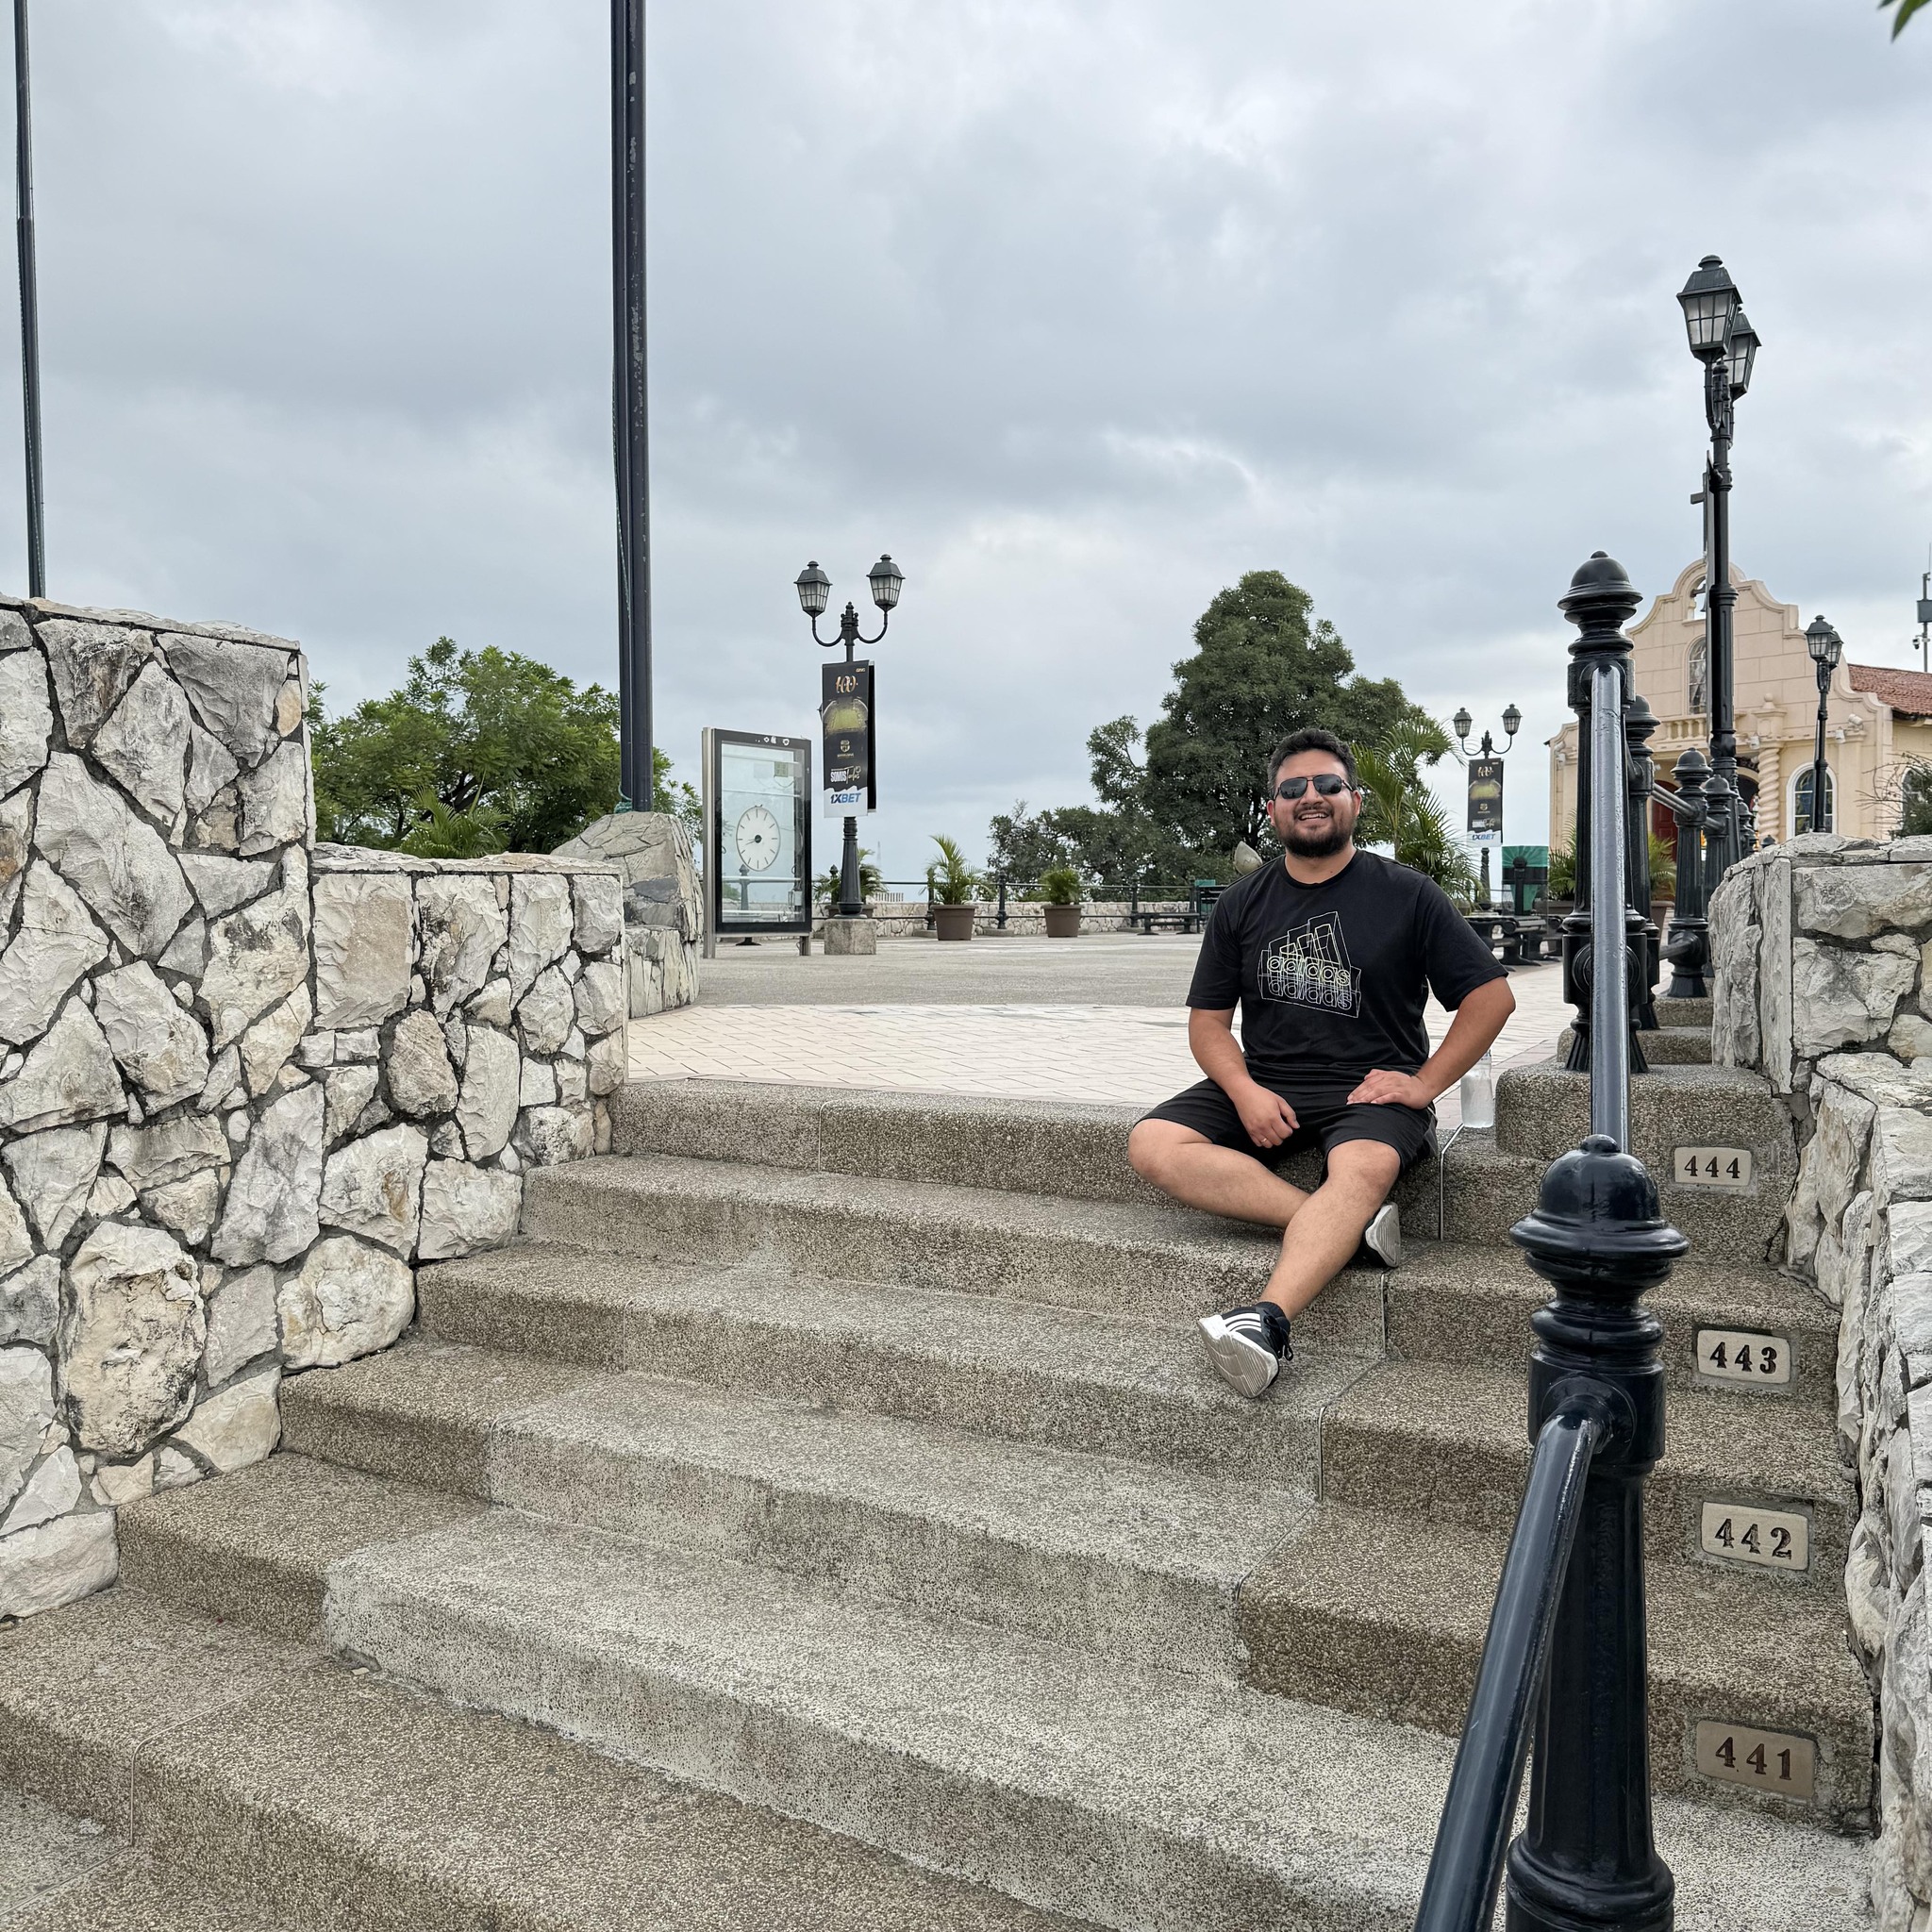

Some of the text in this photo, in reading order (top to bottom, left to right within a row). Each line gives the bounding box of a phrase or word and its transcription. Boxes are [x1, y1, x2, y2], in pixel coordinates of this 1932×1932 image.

[830, 793, 861, 804] 1XBET
[1684, 1156, 1740, 1178] 444
[1709, 1341, 1778, 1374] 443
[1714, 1518, 1792, 1560] 442
[1715, 1737, 1792, 1780] 441
